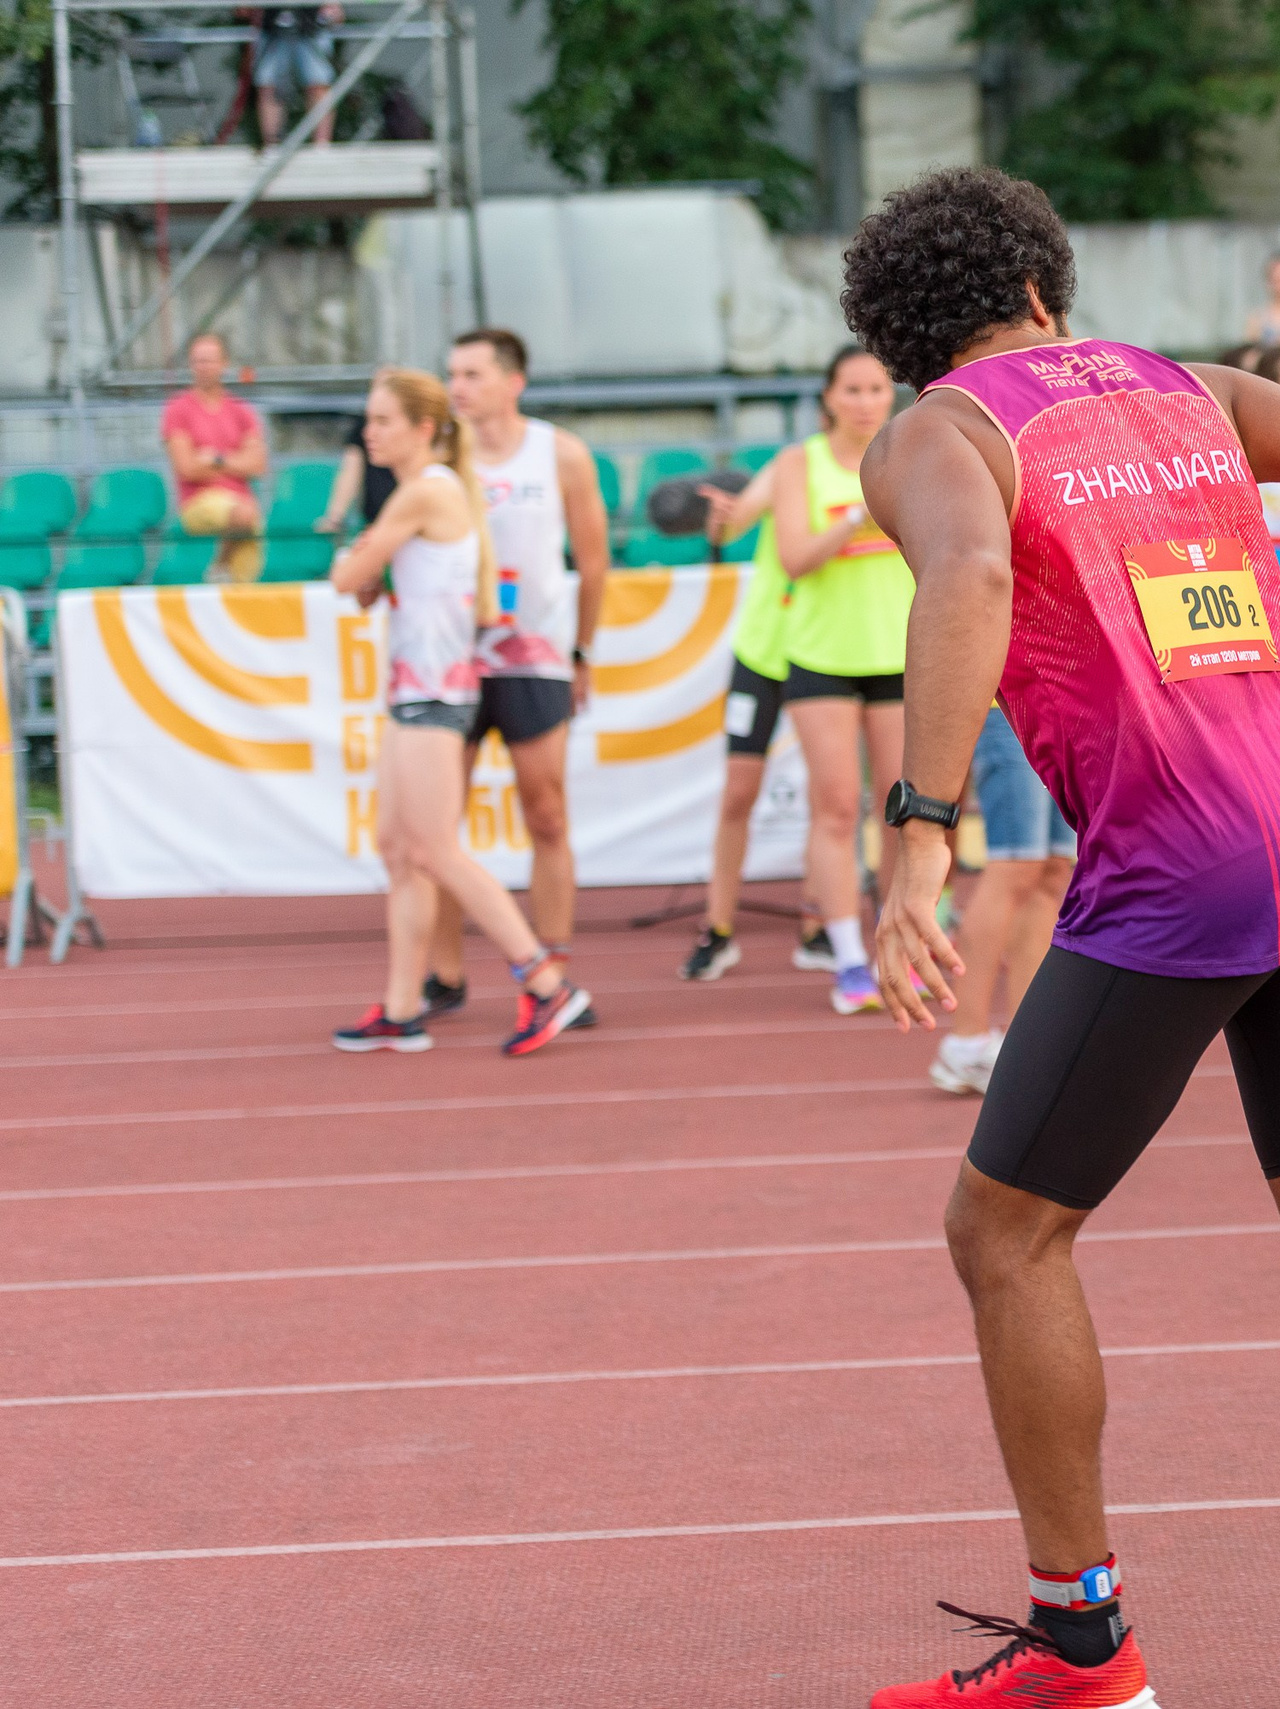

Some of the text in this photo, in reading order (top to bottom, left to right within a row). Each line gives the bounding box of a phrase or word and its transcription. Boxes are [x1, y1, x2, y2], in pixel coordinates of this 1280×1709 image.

[1052, 450, 1248, 506] ZHAN MARK
[1181, 584, 1260, 631] 206 2
[1201, 653, 1221, 666] этап
[1220, 650, 1238, 662] 1200
